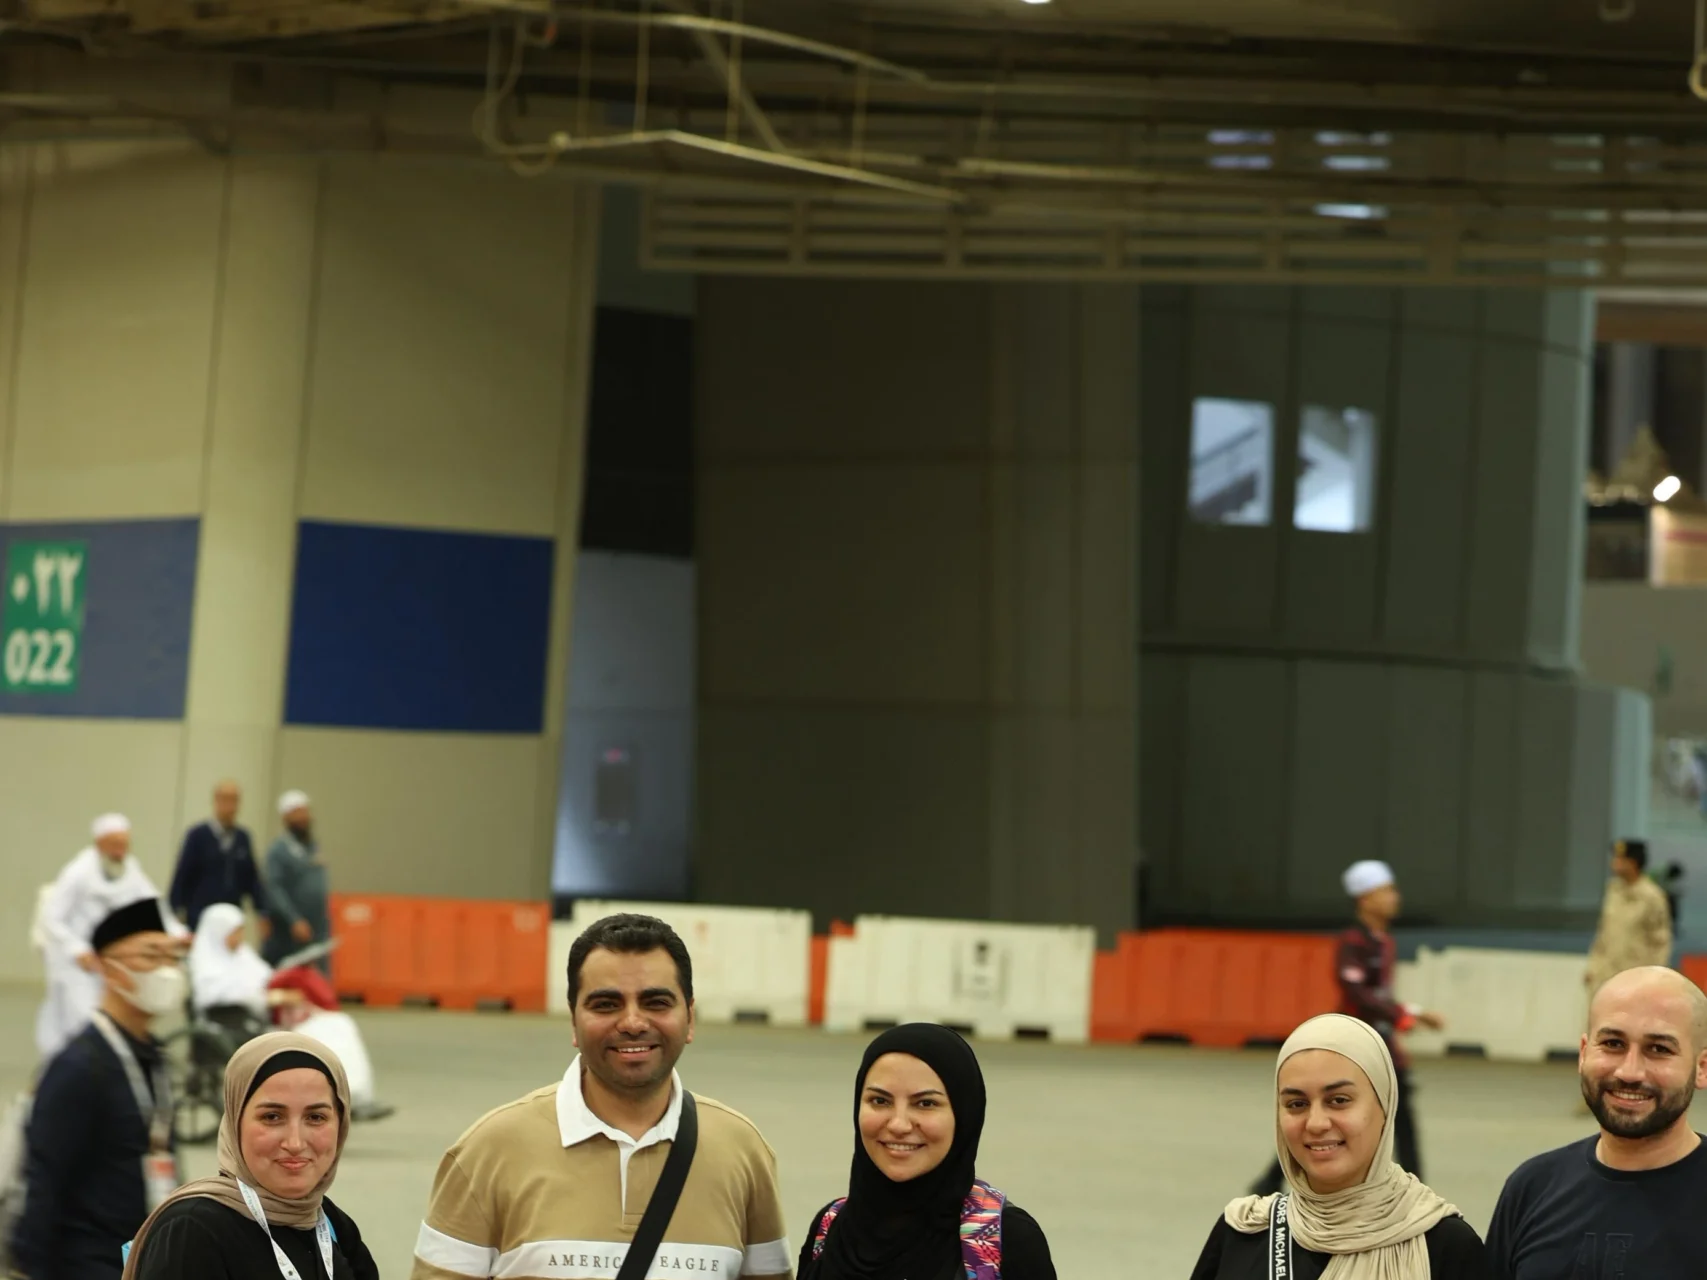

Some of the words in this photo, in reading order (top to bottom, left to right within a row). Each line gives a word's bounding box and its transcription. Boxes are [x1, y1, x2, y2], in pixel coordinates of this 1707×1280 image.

[4, 628, 75, 686] 022
[1276, 1196, 1288, 1224] KORS
[548, 1254, 622, 1268] AMERIC
[660, 1256, 719, 1271] EAGLE
[1275, 1227, 1286, 1280] MICHAEL
